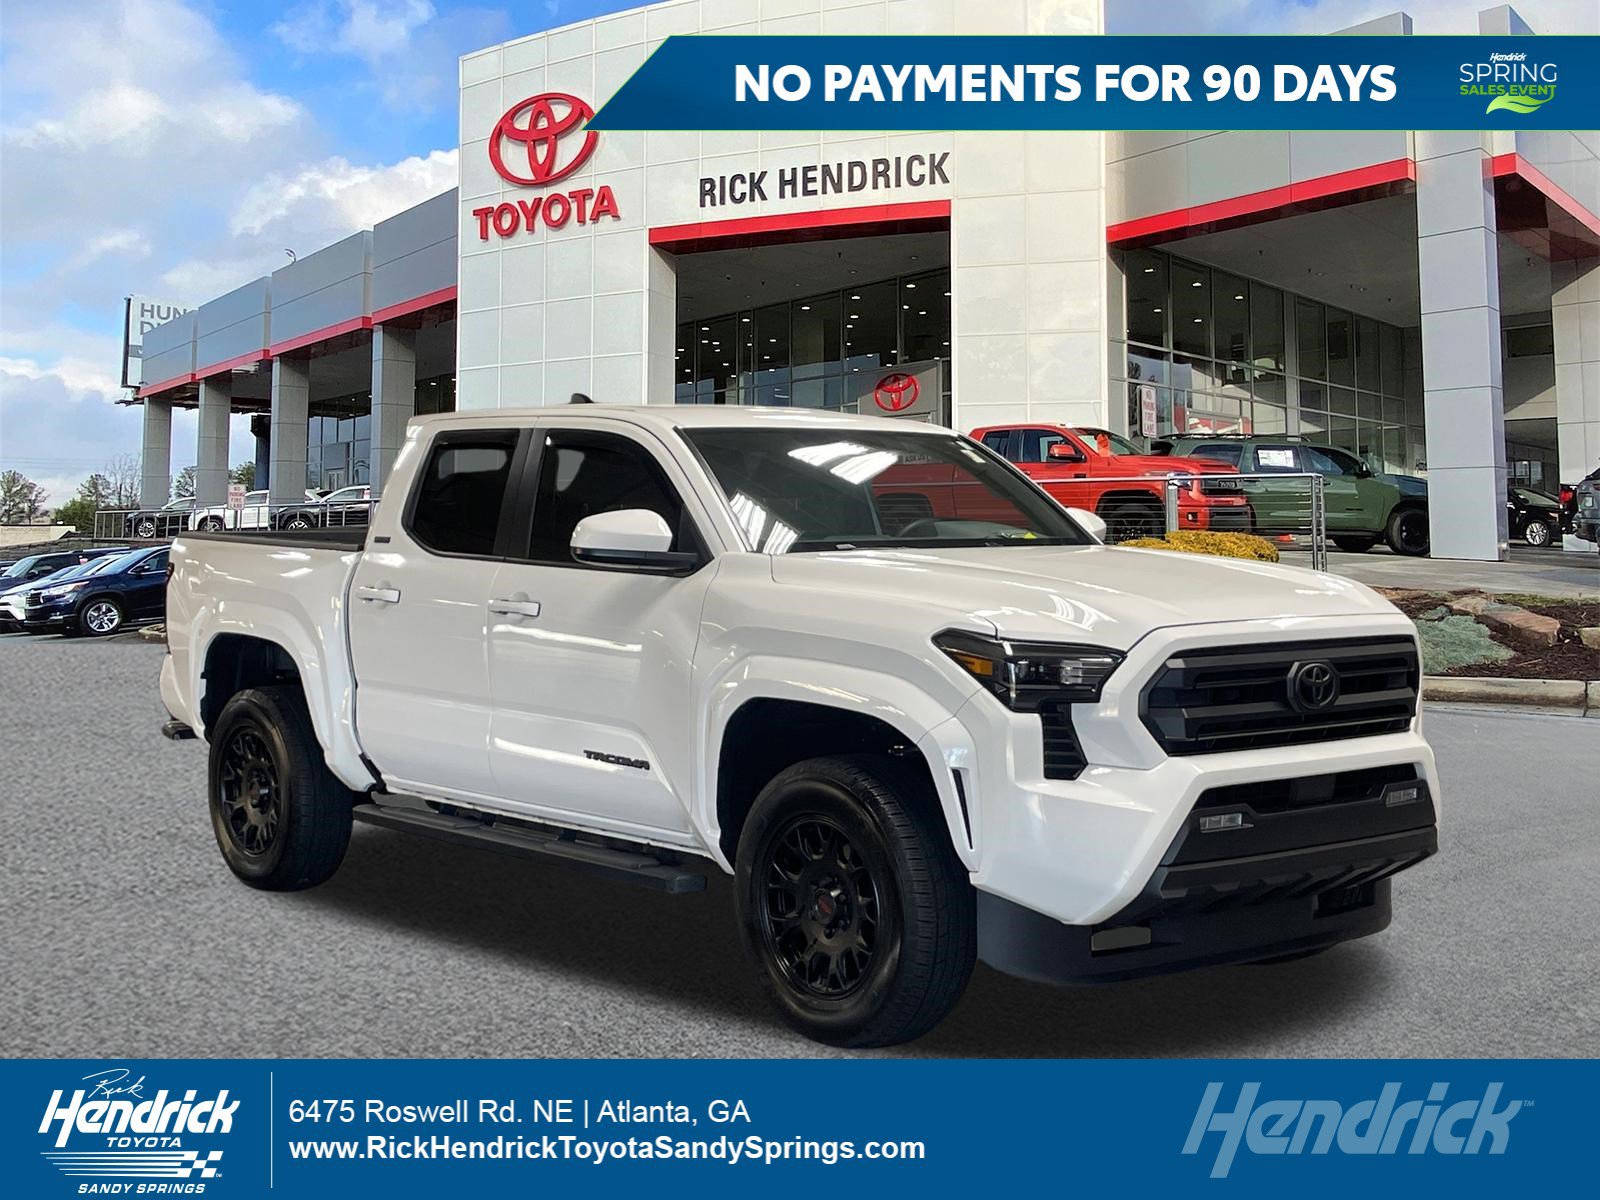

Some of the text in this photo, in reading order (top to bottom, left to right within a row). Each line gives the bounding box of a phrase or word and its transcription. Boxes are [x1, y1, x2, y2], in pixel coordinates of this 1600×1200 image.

[699, 152, 951, 207] RICK HENDRICK
[473, 185, 621, 240] TOYOTA
[583, 749, 650, 771] TACOMA
